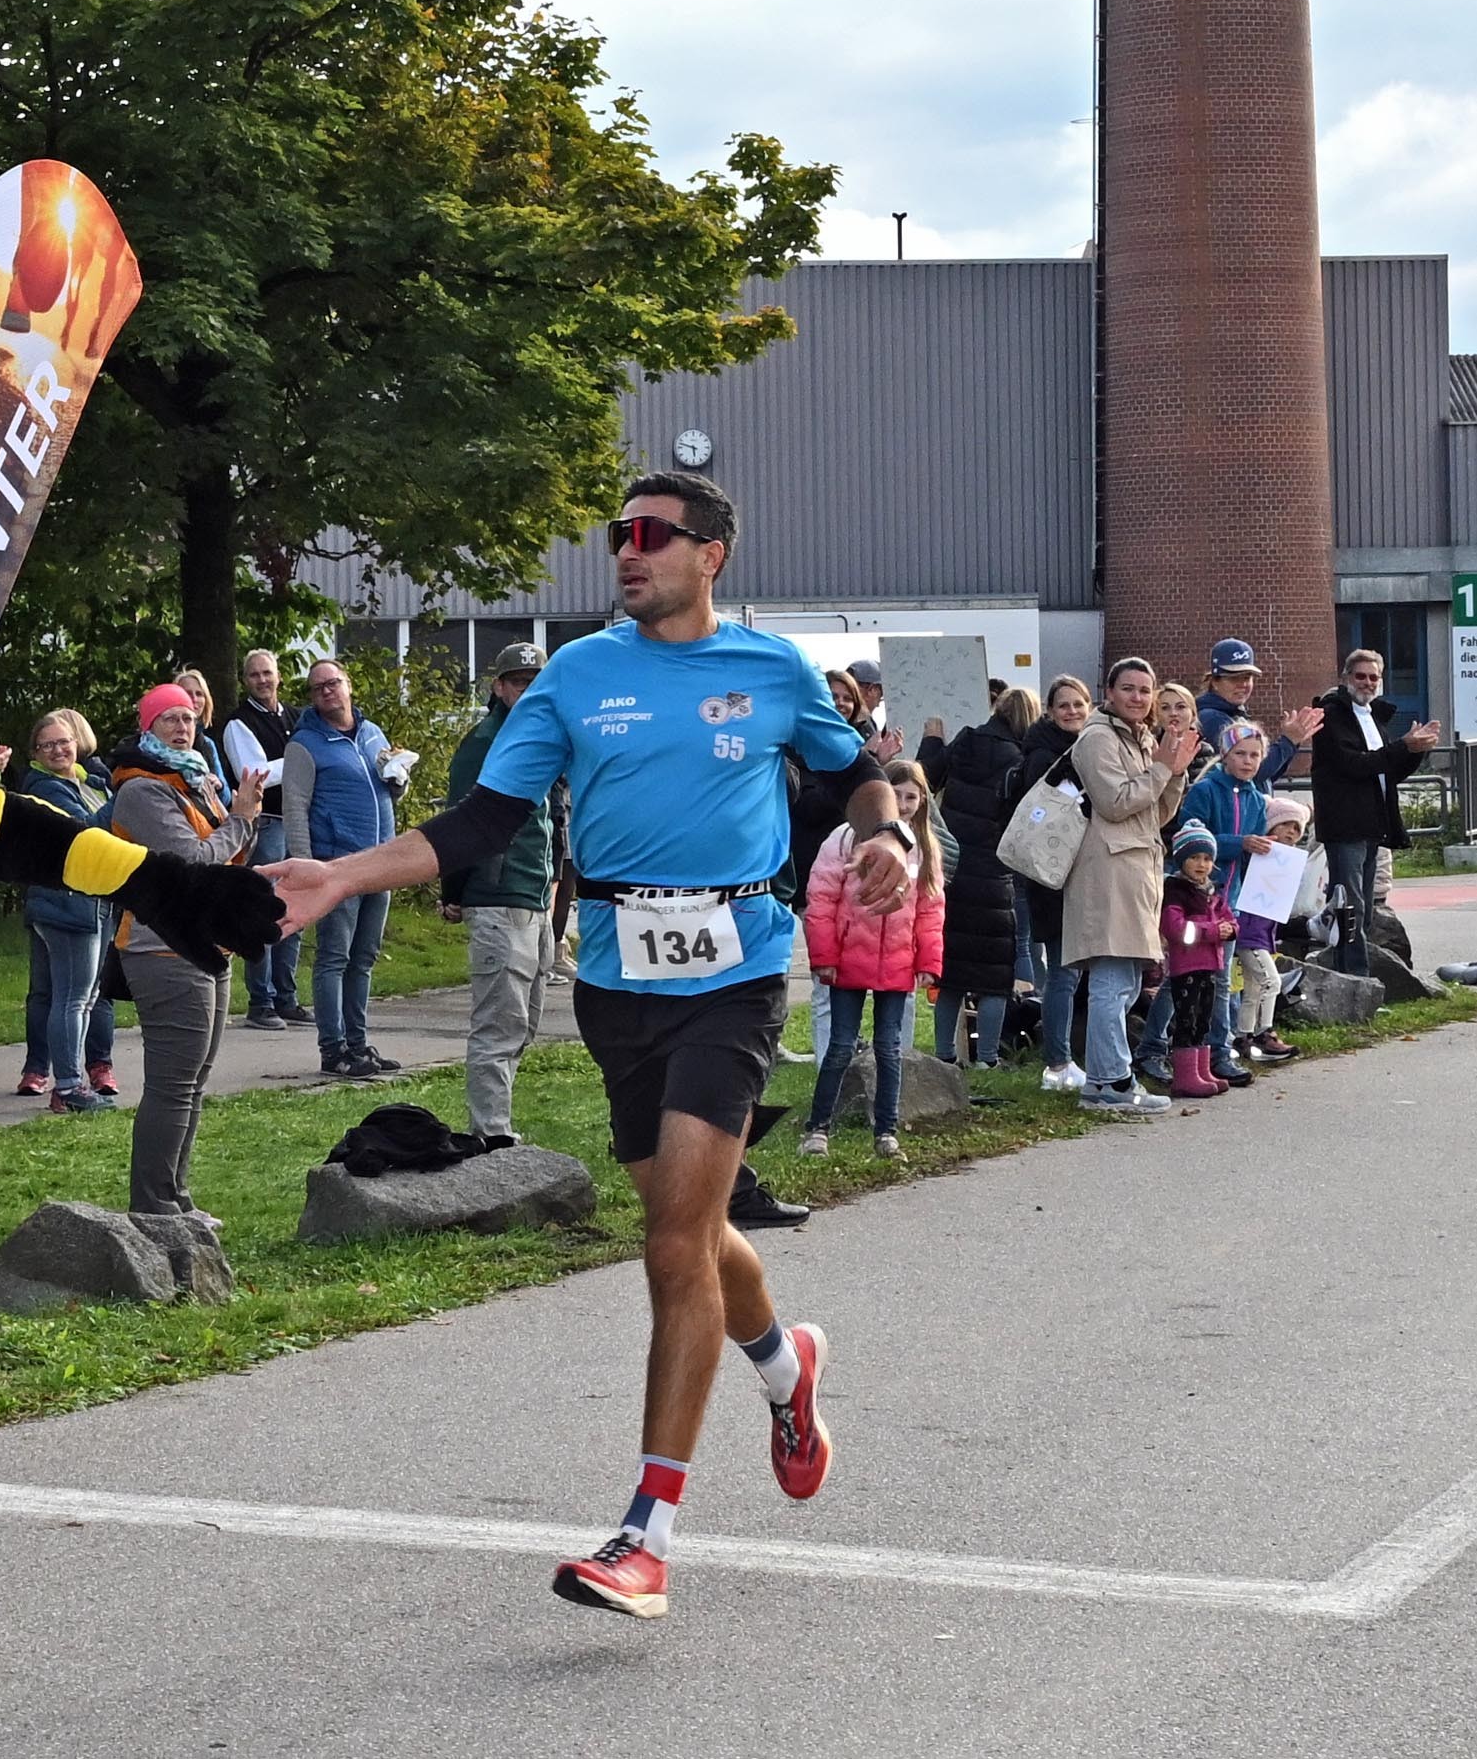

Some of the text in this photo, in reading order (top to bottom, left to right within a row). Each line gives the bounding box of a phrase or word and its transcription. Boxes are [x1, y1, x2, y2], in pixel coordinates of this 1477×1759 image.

[1457, 583, 1474, 618] 1
[1460, 652, 1477, 662] die
[599, 696, 636, 709] JAKO
[601, 723, 628, 736] PIO
[713, 733, 746, 762] 55
[639, 927, 718, 965] 134
